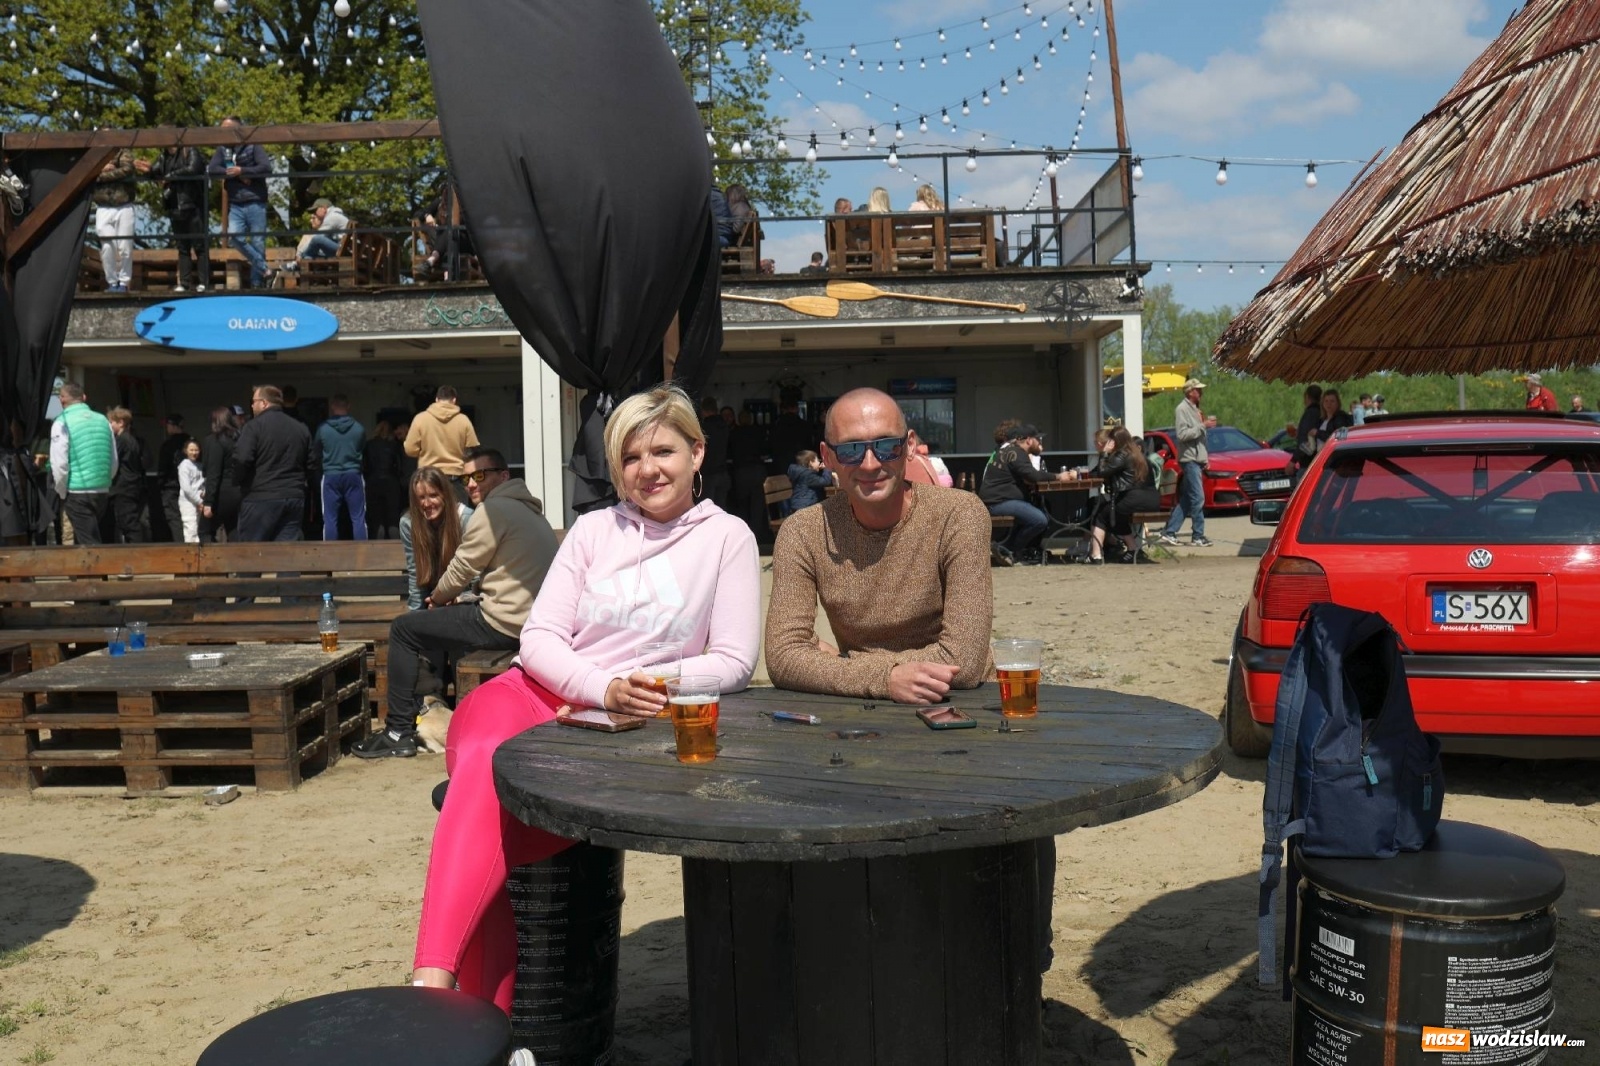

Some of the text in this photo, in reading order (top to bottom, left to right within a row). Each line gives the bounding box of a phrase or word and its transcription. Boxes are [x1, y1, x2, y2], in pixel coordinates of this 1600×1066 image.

[1434, 610, 1445, 618] PL
[1311, 942, 1366, 970] DEVELOPED FOR
[1310, 951, 1332, 968] PETROL
[1337, 966, 1366, 980] DIESEL
[1320, 966, 1348, 983] ENGINES
[1310, 970, 1365, 1004] SAE 5W-30
[1314, 1020, 1329, 1034] ACEA
[1326, 1037, 1348, 1052] SN/CF
[1331, 1049, 1348, 1063] Ford
